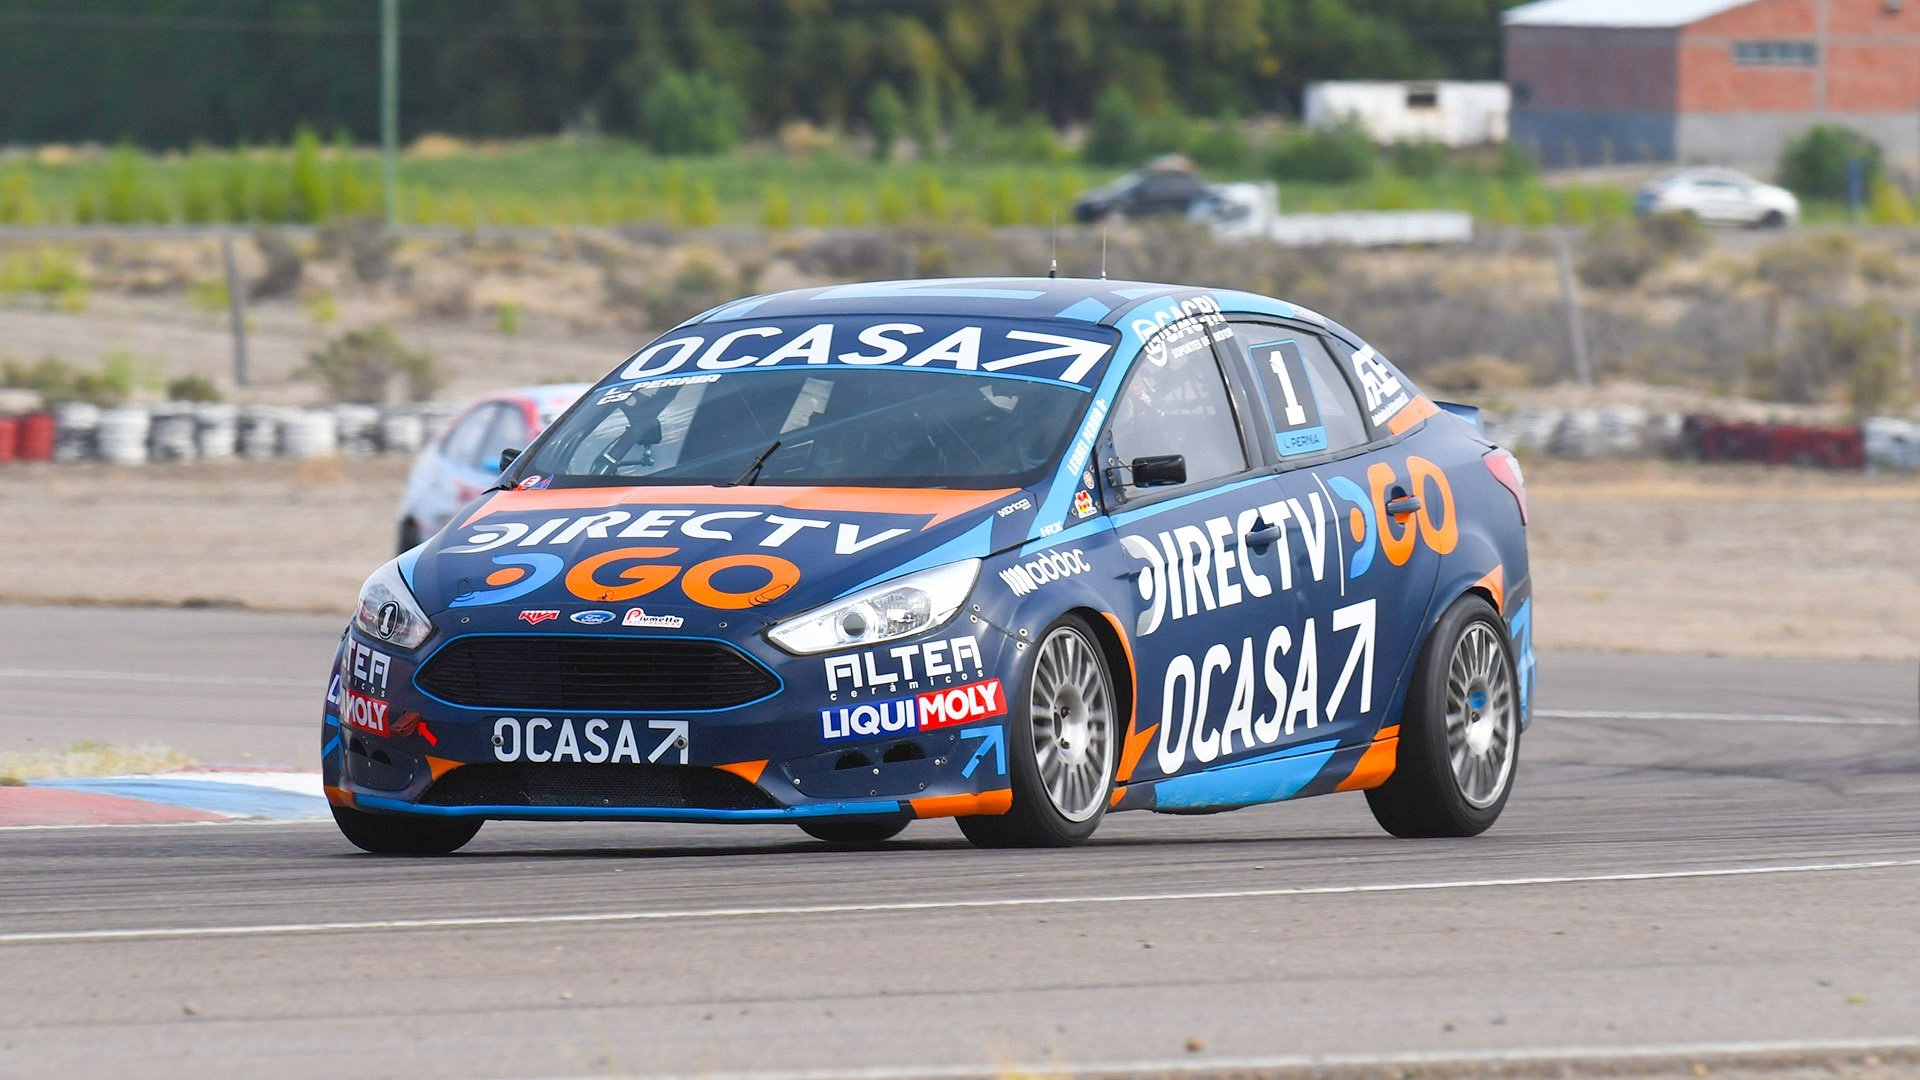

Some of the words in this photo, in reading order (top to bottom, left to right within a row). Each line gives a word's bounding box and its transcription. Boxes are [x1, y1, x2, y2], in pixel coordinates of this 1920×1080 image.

[620, 323, 982, 380] OCASA
[630, 374, 721, 391] PERNIA
[1269, 350, 1307, 426] 1
[436, 510, 911, 555] DIRECTV
[1120, 491, 1325, 637] DIRECTV
[379, 604, 391, 635] 1
[824, 635, 983, 691] ALTEA
[822, 699, 915, 738] LIQUI
[918, 681, 998, 725] MOLY
[1157, 617, 1318, 774] OCASA
[493, 717, 640, 764] OCASA
